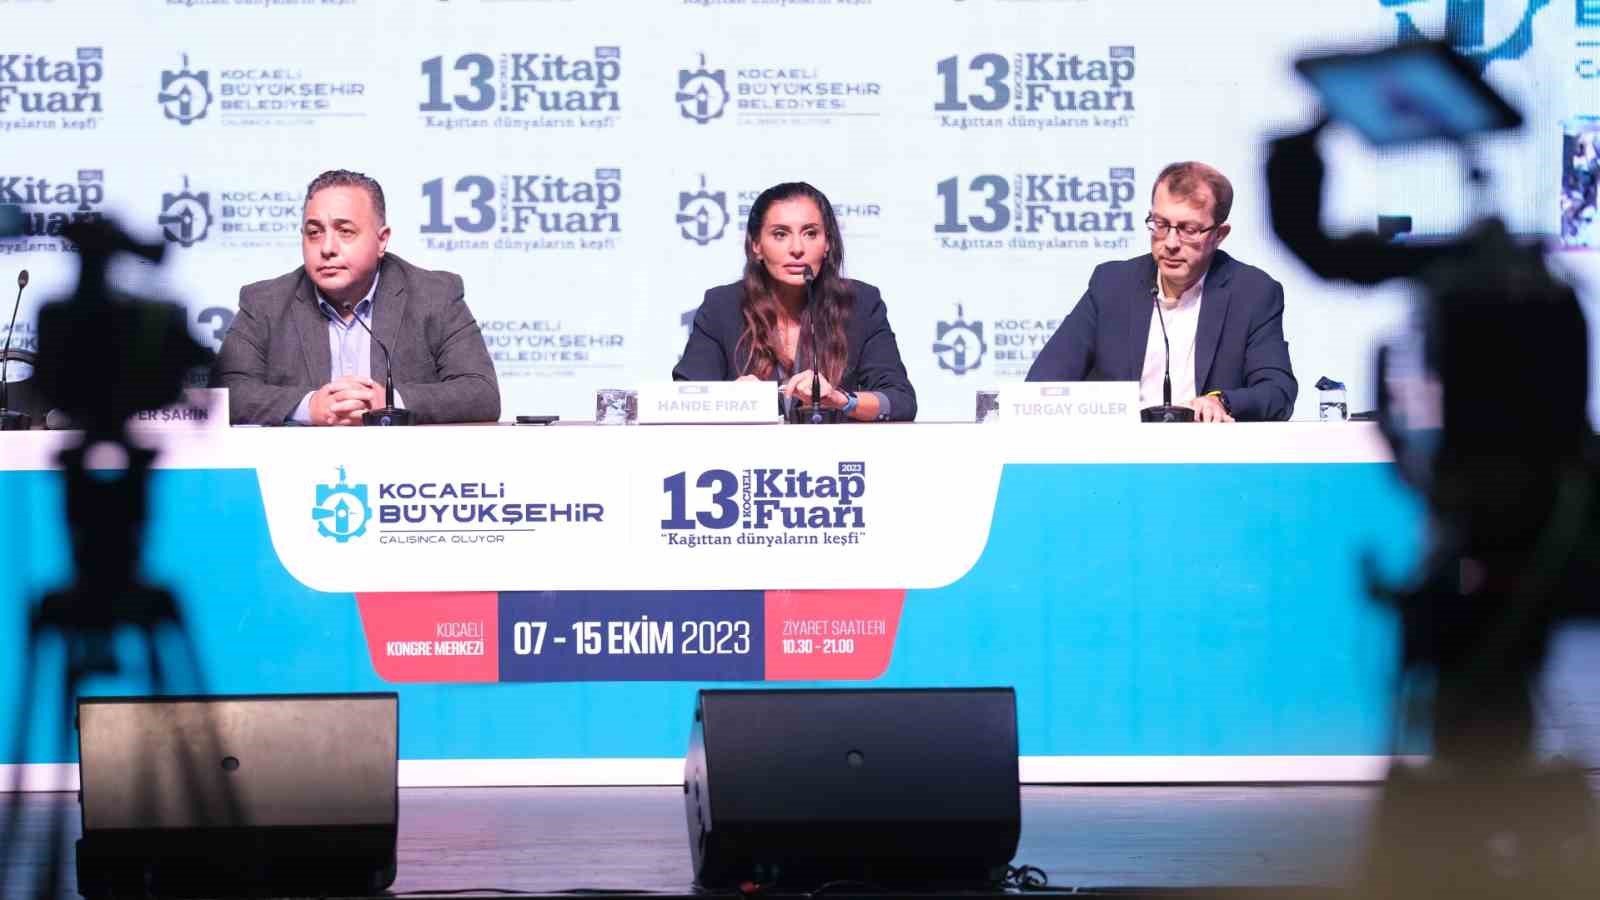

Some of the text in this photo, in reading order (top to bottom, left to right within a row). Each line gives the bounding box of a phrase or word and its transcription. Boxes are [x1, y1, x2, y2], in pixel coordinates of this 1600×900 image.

[511, 53, 621, 88] Kitap
[1026, 53, 1135, 88] Kitap
[511, 84, 621, 112] Fuarı
[1026, 83, 1135, 111] Fuarı
[512, 175, 621, 210] Kitap
[1026, 174, 1135, 210] Kitap
[512, 206, 621, 233] Fuarı
[1026, 205, 1135, 232] Fuarı
[657, 399, 713, 412] HANDE
[1012, 402, 1073, 416] TURGAY
[840, 463, 864, 474] 2023
[753, 468, 866, 506] Kitap
[753, 499, 866, 529] Fuarı
[451, 534, 505, 544] OLUYOR
[736, 530, 819, 548] dünyaların
[386, 640, 433, 656] KONGRE
[513, 621, 548, 655] 07
[571, 621, 602, 655] 15
[607, 615, 674, 655] EKİM
[681, 620, 751, 655] 2023
[783, 639, 812, 654] 10.30
[823, 639, 854, 654] 21.00
